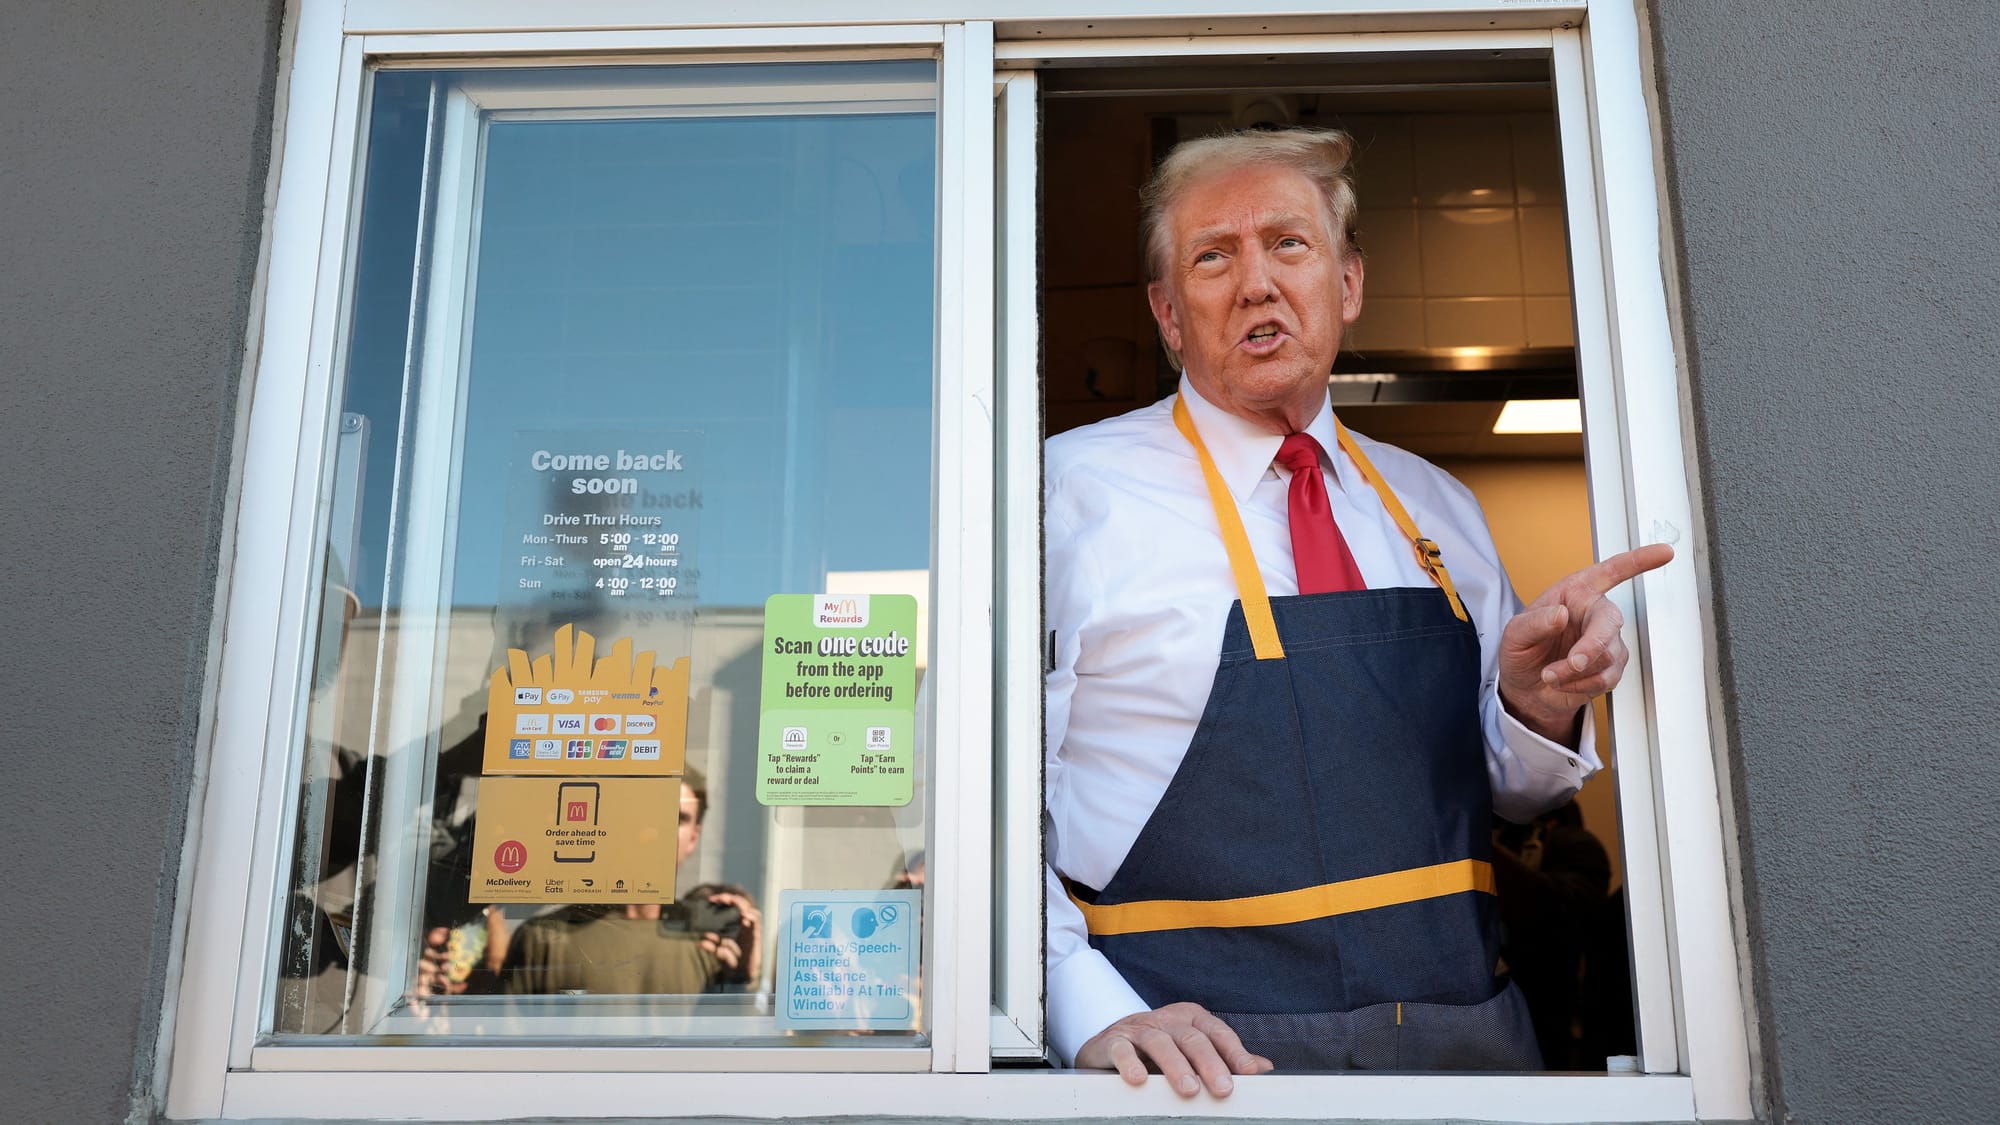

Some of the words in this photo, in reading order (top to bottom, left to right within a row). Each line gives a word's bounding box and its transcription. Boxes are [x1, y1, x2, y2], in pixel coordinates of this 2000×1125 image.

[531, 449, 610, 471] Come
[616, 449, 683, 471] back
[571, 477, 638, 494] soon
[543, 513, 580, 525] Drive
[583, 513, 615, 525] Thru
[619, 513, 662, 526] Hours
[642, 533, 679, 545] 12:00
[593, 558, 621, 568] open
[622, 555, 644, 569] 24
[645, 557, 678, 567] hours
[519, 578, 541, 588] Sun
[640, 577, 677, 589] 12:00
[824, 602, 839, 613] My
[820, 615, 863, 623] Rewards
[774, 636, 812, 654] Scan
[818, 635, 857, 657] one
[859, 630, 909, 657] code
[797, 661, 829, 677] from
[832, 661, 855, 677] the
[858, 664, 884, 680] app
[525, 693, 539, 701] Pay
[559, 693, 570, 702] Pay
[786, 682, 831, 698] before
[834, 682, 893, 702] ordering
[584, 696, 601, 704] pay
[558, 720, 580, 728] VISA
[567, 745, 592, 753] JCB
[768, 754, 781, 765] Tap
[860, 754, 873, 765] Tap
[776, 765, 784, 773] to
[785, 765, 805, 773] claim
[879, 766, 887, 774] to
[767, 776, 792, 785] reward
[803, 776, 819, 785] deal
[545, 829, 569, 837] Order
[571, 829, 596, 837] ahead
[576, 838, 596, 846] time
[486, 878, 531, 887] McDelivery
[793, 956, 850, 969] Impaired
[793, 970, 867, 982] Assistance
[793, 984, 854, 997] Available
[858, 985, 872, 996] At
[877, 984, 905, 996] This
[793, 999, 845, 1010] Window
